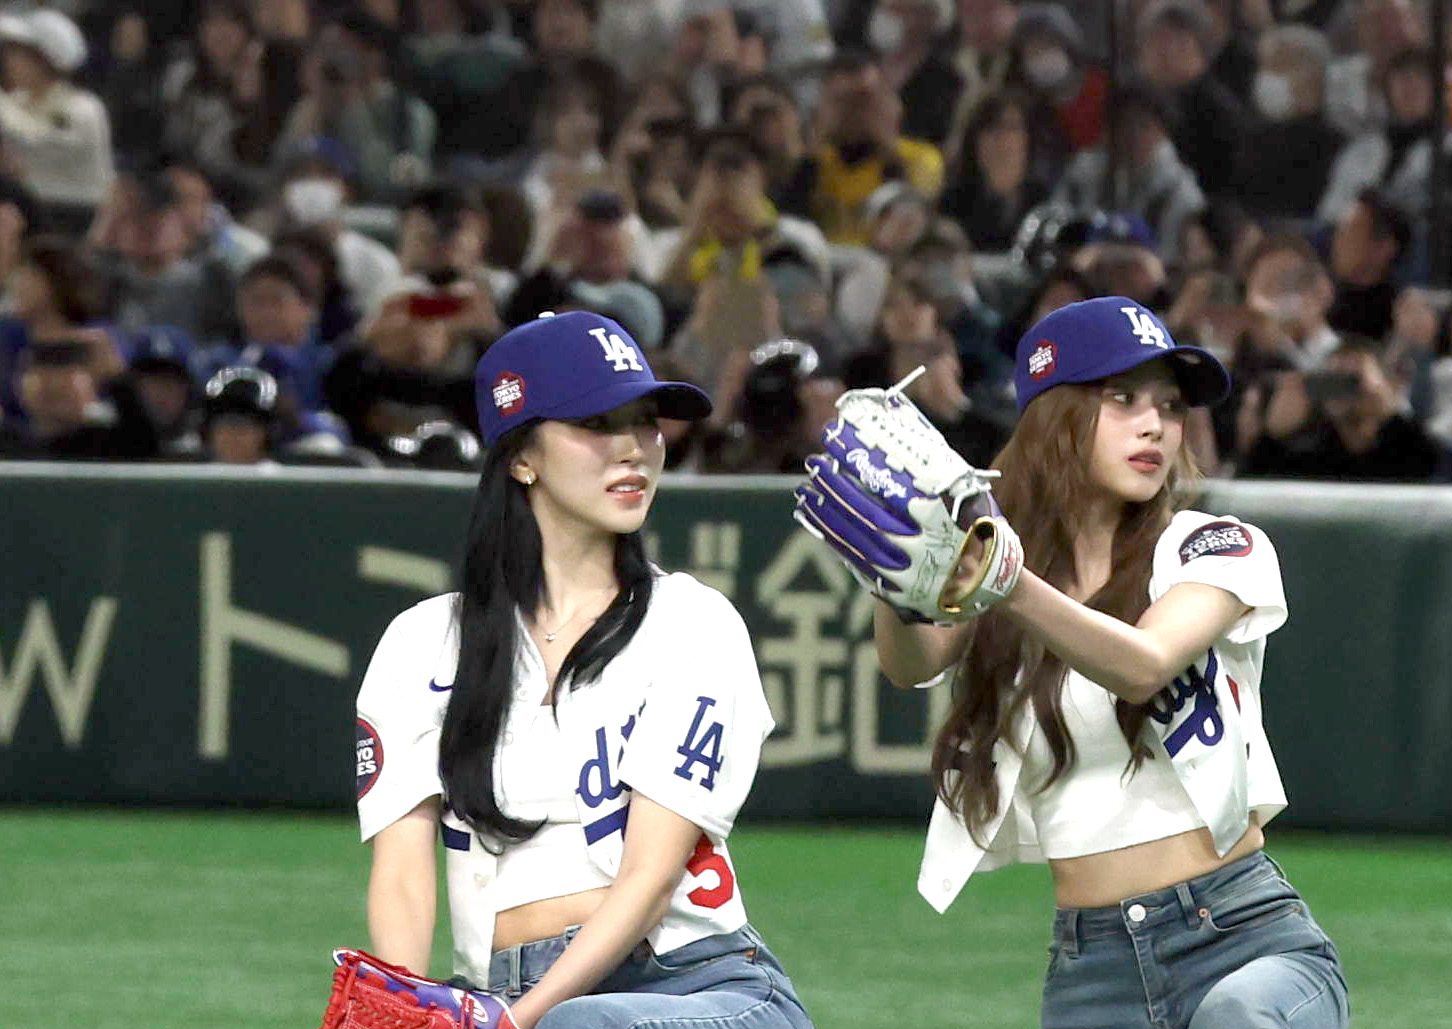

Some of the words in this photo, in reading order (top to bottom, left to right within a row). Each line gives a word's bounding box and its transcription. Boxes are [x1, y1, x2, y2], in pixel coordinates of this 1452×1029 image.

[588, 327, 643, 372] LA
[1120, 307, 1168, 349] LA
[672, 695, 725, 792] LA
